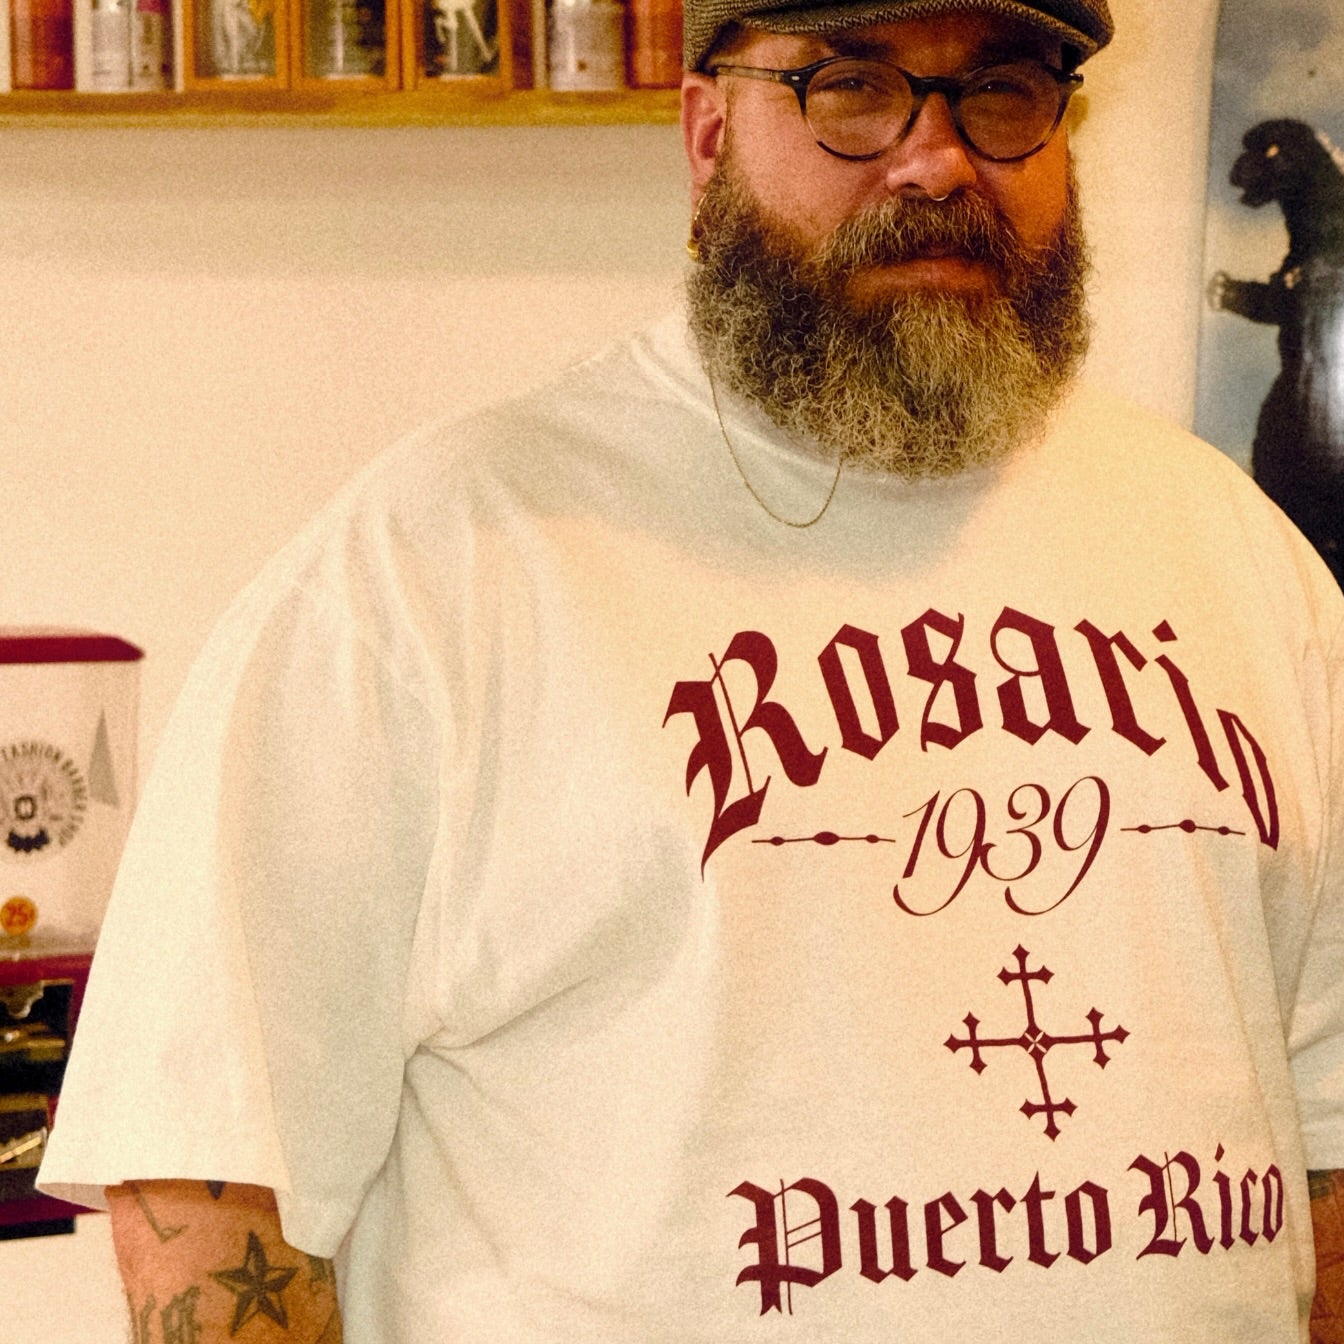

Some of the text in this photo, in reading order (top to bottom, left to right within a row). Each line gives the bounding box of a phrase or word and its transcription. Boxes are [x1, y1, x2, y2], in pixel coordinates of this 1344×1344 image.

[661, 606, 1278, 882] Rosario
[892, 775, 1111, 917] 1939
[726, 1142, 1285, 1317] Puerto Rico
